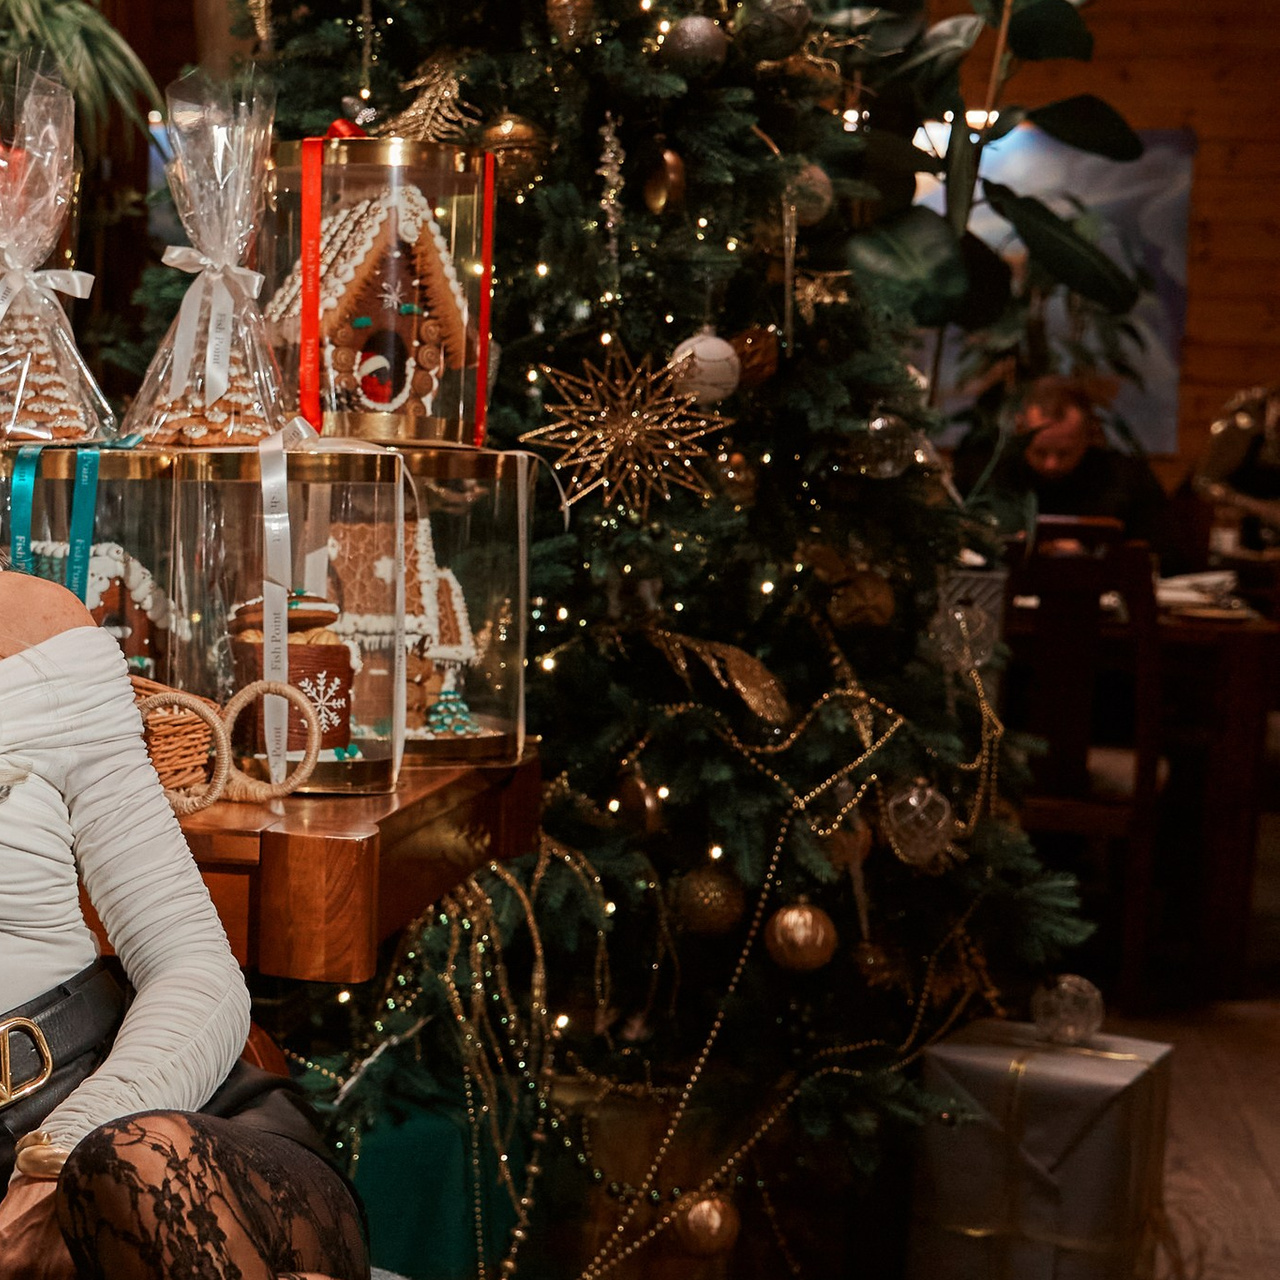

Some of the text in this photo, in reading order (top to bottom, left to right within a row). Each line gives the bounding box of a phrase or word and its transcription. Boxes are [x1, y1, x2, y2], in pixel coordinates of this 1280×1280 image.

[213, 313, 226, 365] Fish Point
[15, 535, 26, 559] Fish
[71, 565, 83, 595] Poin
[270, 612, 281, 670] Fish Point
[271, 727, 281, 757] Point
